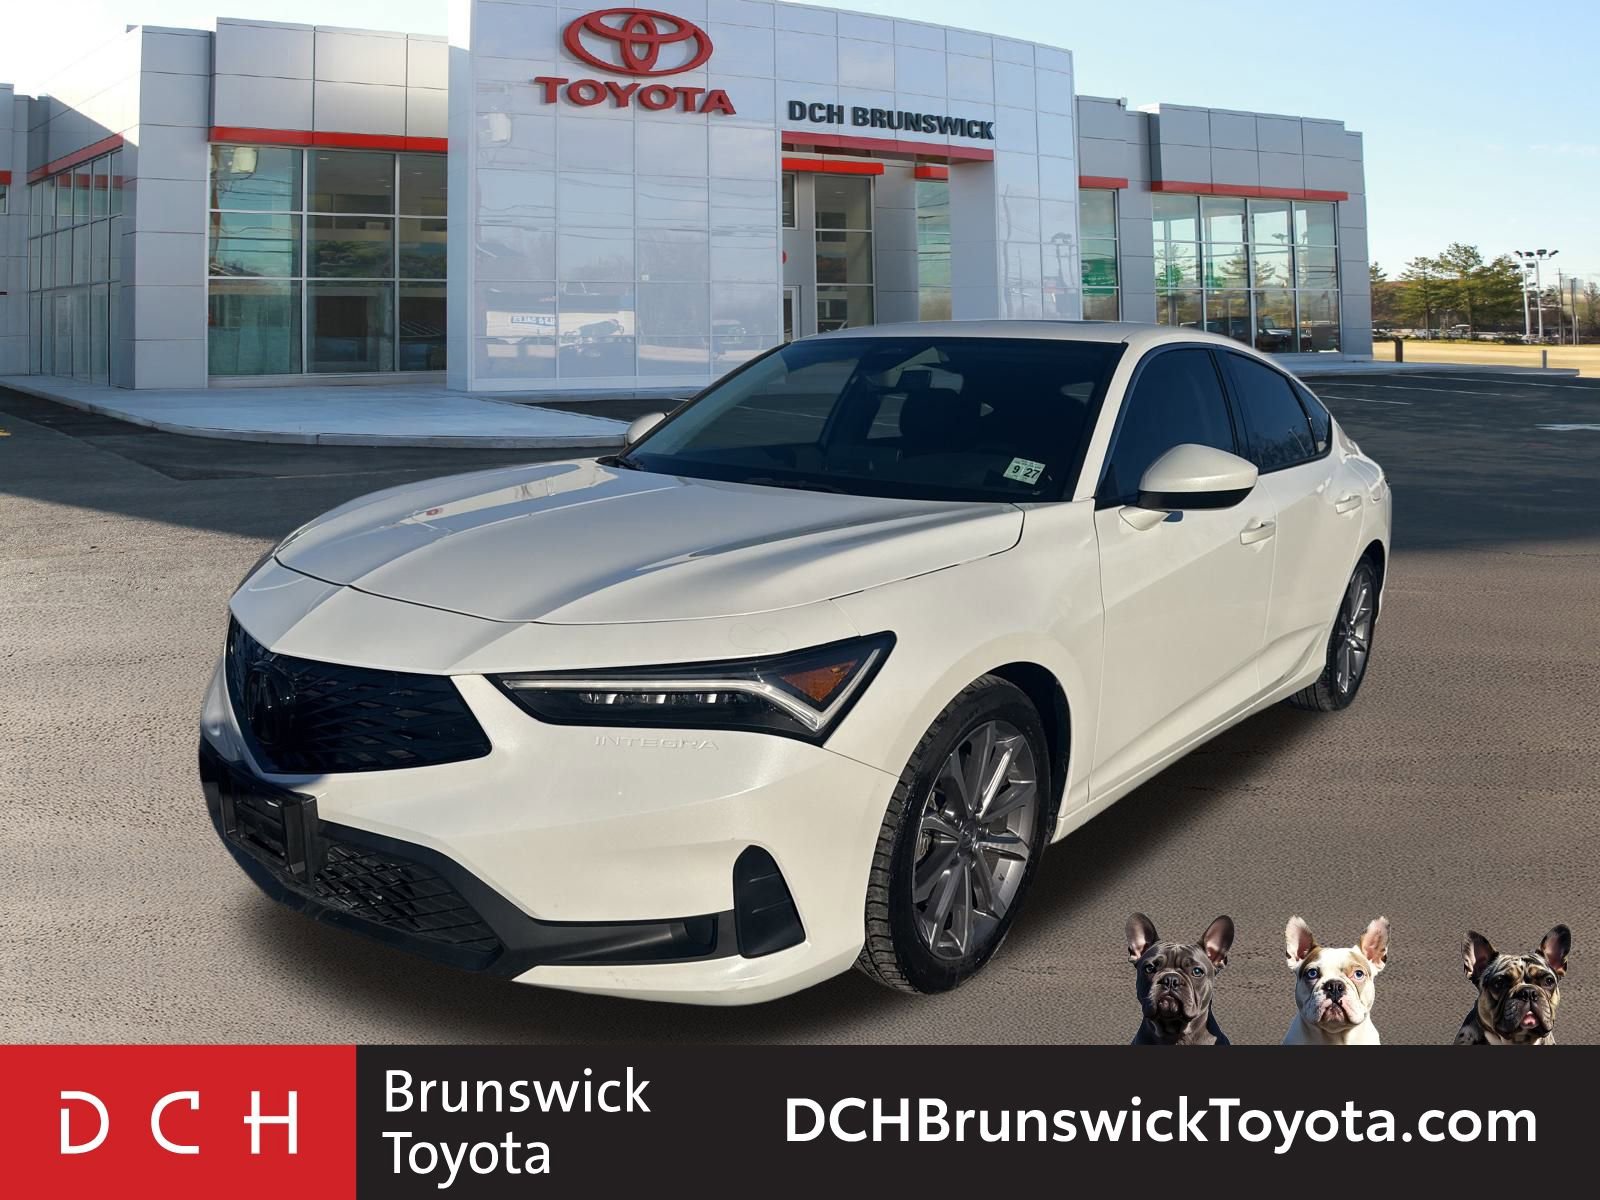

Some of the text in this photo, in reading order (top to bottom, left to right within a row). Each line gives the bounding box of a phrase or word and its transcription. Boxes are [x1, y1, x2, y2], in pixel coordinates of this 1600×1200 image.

[534, 76, 737, 115] TOYOTA
[788, 100, 994, 140] DCH BRUNSWICK
[1012, 465, 1041, 479] 9 27
[595, 735, 720, 751] INTEGRA
